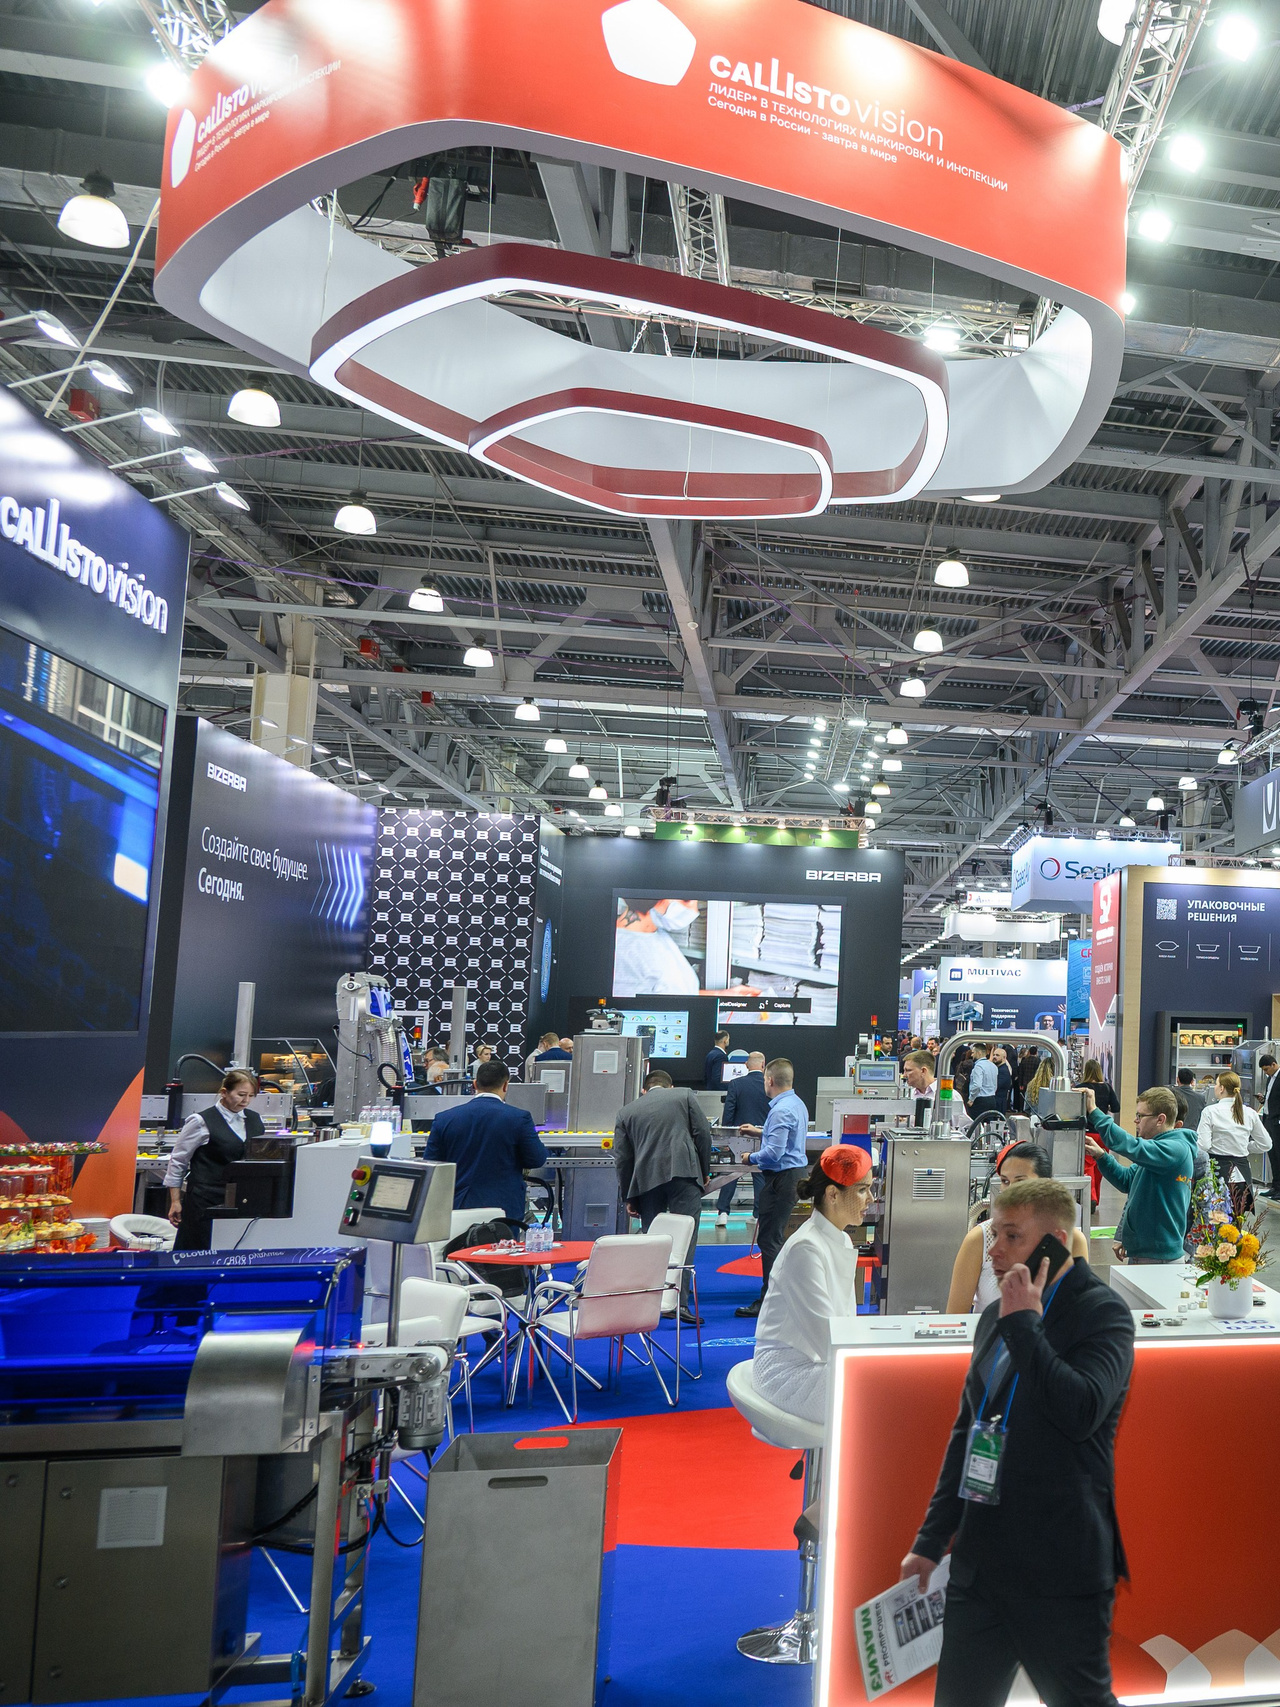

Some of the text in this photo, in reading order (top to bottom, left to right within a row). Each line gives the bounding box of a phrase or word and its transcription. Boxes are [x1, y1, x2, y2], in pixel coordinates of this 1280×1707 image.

[708, 96, 757, 120] Сегодня
[760, 111, 767, 122] в
[770, 113, 811, 136] России
[822, 131, 858, 151] завтра
[861, 143, 868, 153] в
[870, 146, 897, 164] мире
[760, 98, 768, 108] В
[772, 100, 857, 137] ТЕХНОЛОГИЯХ
[860, 129, 933, 163] МАРКИРОВКИ
[937, 157, 944, 167] И
[947, 160, 1008, 192] ИНСПЕКЦИИ
[207, 762, 247, 792] BIZERBA
[201, 826, 309, 882] Создайте свое будущее.
[198, 867, 245, 902] Сегодня.
[805, 870, 881, 882] BIZERBA
[1187, 900, 1266, 912] УПАКОВОЧНЫЕ
[1187, 912, 1237, 923] РЕШЕНИЯ
[967, 968, 1022, 977] MULTIVAC
